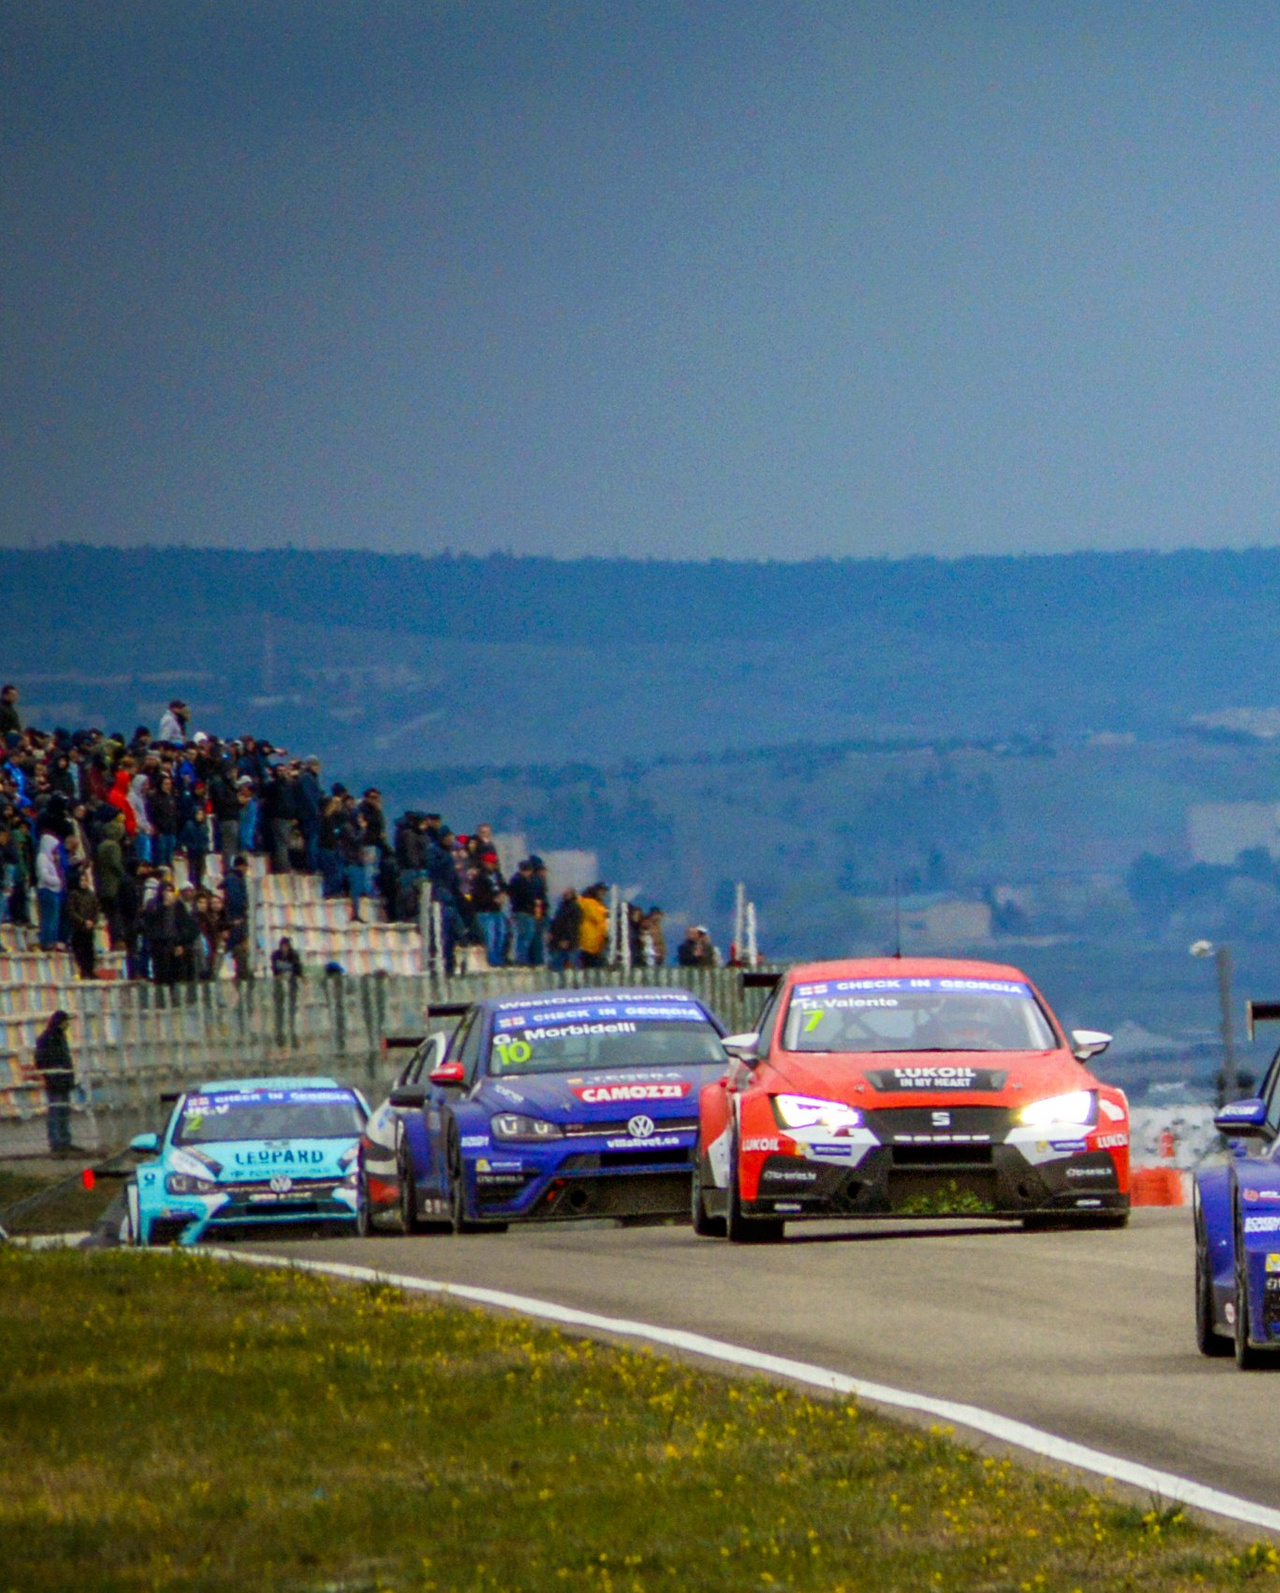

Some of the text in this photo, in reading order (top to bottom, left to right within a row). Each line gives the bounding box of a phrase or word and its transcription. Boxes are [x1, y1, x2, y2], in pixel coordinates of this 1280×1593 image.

[837, 979, 1022, 994] CHECK IN GEORGIA
[500, 993, 688, 1009] WestCoast Racing
[533, 1007, 700, 1022] CHECK IN GEORGIA
[803, 1010, 824, 1032] 7
[493, 1023, 637, 1045] G. Morbidelli
[496, 1041, 532, 1066] 10
[894, 1067, 976, 1078] LUKOIL
[900, 1077, 971, 1087] IN MY HEART
[582, 1085, 682, 1102] CAMOZZI
[186, 1115, 203, 1131] 2
[742, 1138, 779, 1152] LUKOIL
[235, 1150, 324, 1166] LEOPARD
